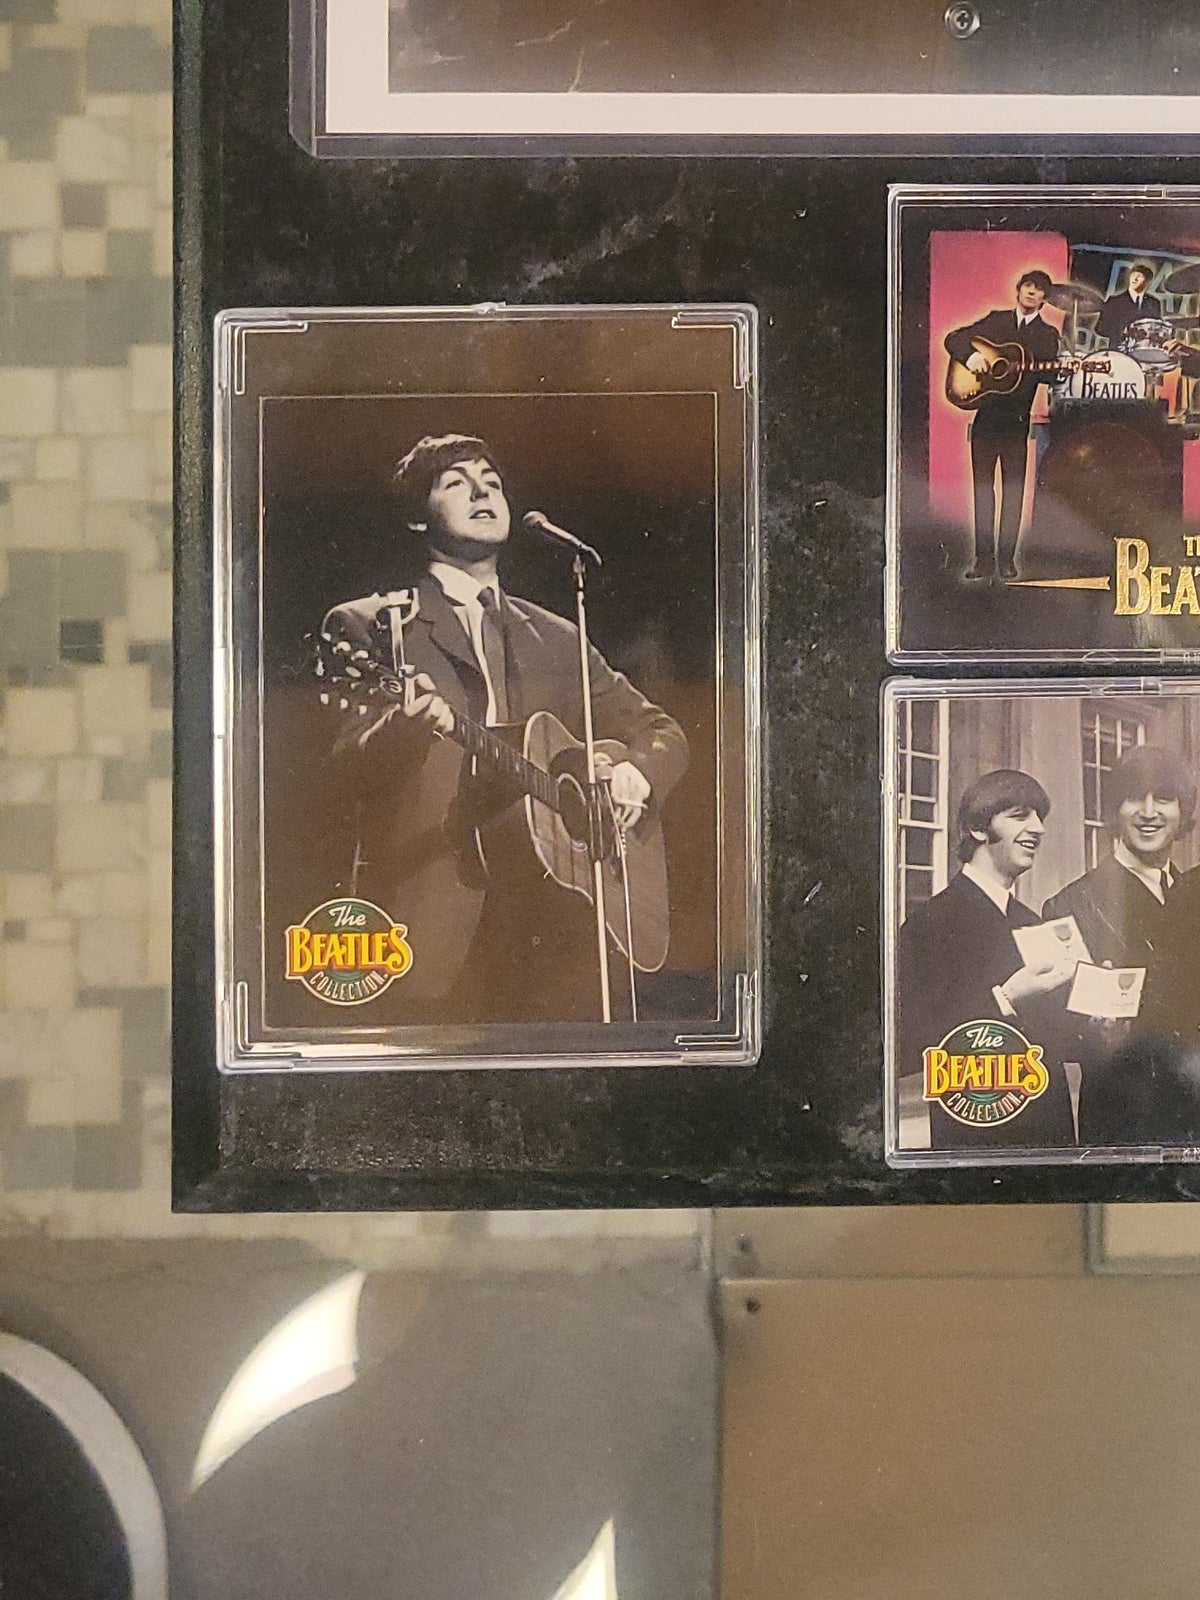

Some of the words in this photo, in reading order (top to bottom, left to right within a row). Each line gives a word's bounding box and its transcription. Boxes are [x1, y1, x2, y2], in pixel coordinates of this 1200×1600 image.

[328, 904, 367, 927] The
[292, 928, 411, 973] BEATLES
[965, 1026, 1004, 1048] The
[929, 1048, 1047, 1094] BEATLES
